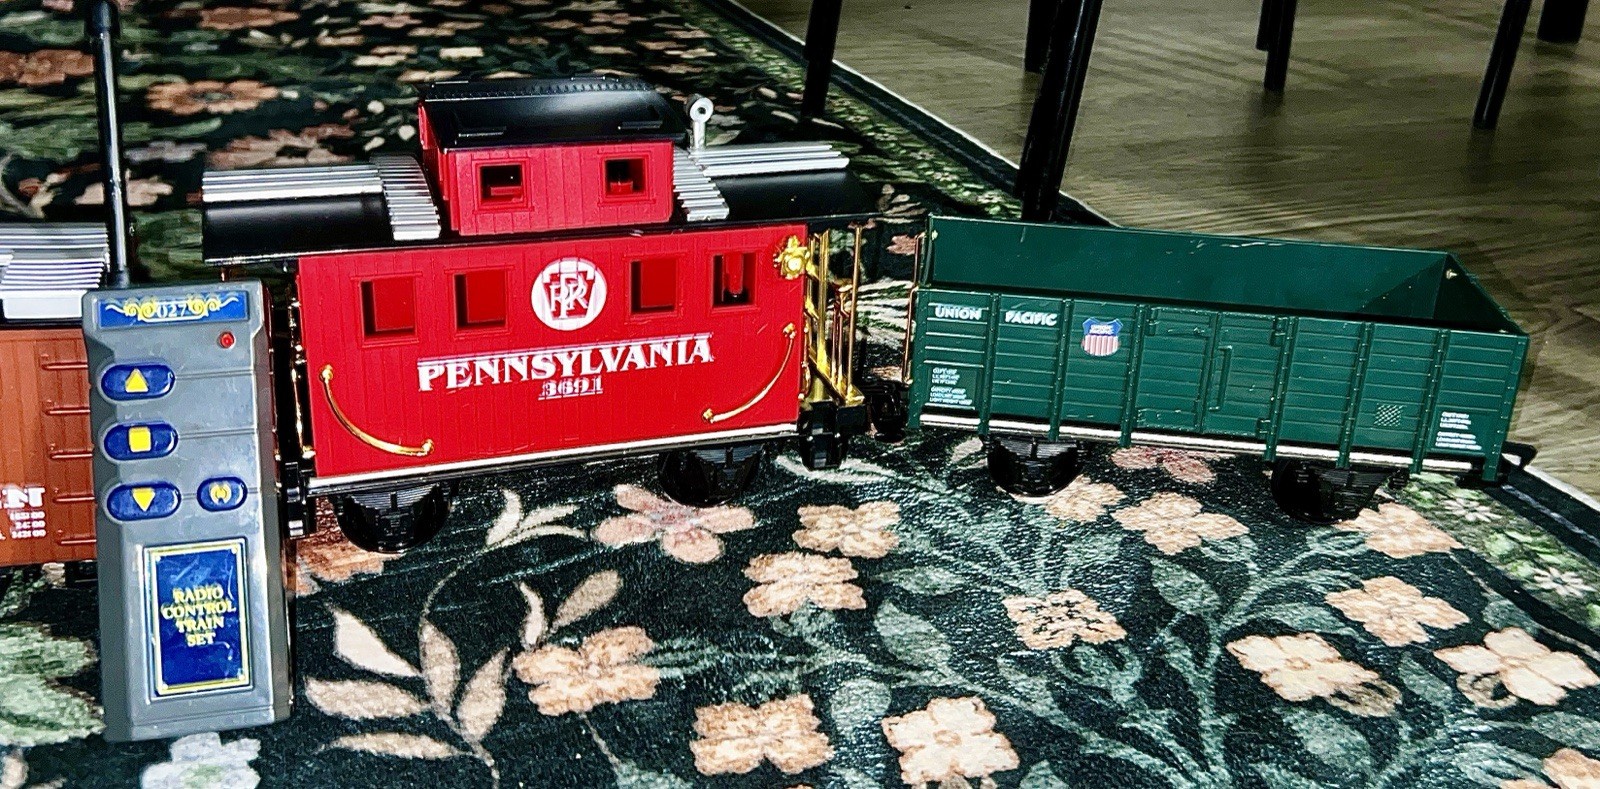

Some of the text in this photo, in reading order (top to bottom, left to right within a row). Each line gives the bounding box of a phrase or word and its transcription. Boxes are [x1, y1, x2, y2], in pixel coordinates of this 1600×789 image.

[157, 303, 187, 317] 027
[934, 305, 1058, 326] UNION PACIFIC
[417, 335, 715, 393] PENNSYLVANIA
[541, 376, 604, 397] 3691
[172, 584, 225, 604] RADIO
[161, 600, 237, 620] CONTROL
[175, 616, 225, 633] TRAIN
[186, 632, 217, 647] SET
